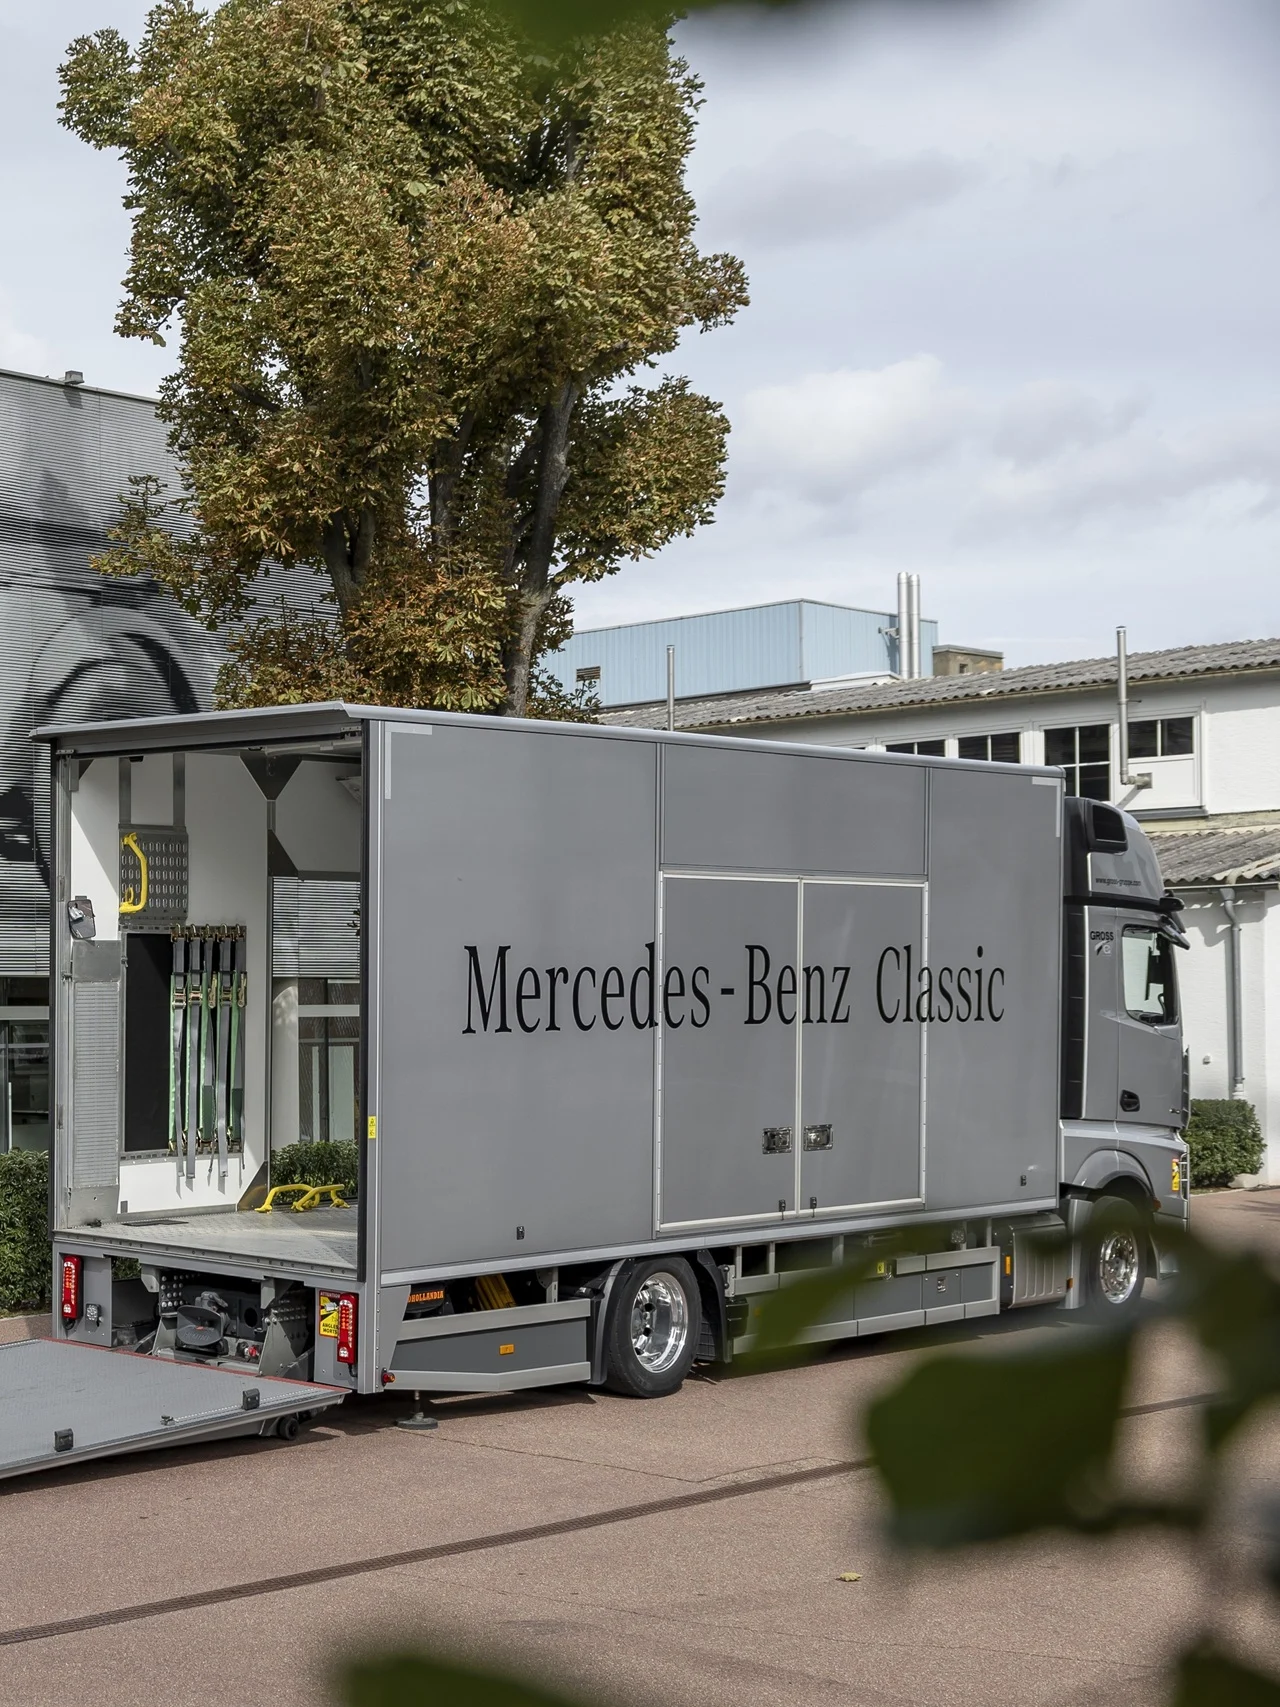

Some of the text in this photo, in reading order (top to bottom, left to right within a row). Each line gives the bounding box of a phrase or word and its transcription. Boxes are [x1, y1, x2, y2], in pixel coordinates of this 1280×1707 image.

[1090, 930, 1114, 941] GROSS
[462, 941, 1005, 1035] Mercedes-Benz Classic
